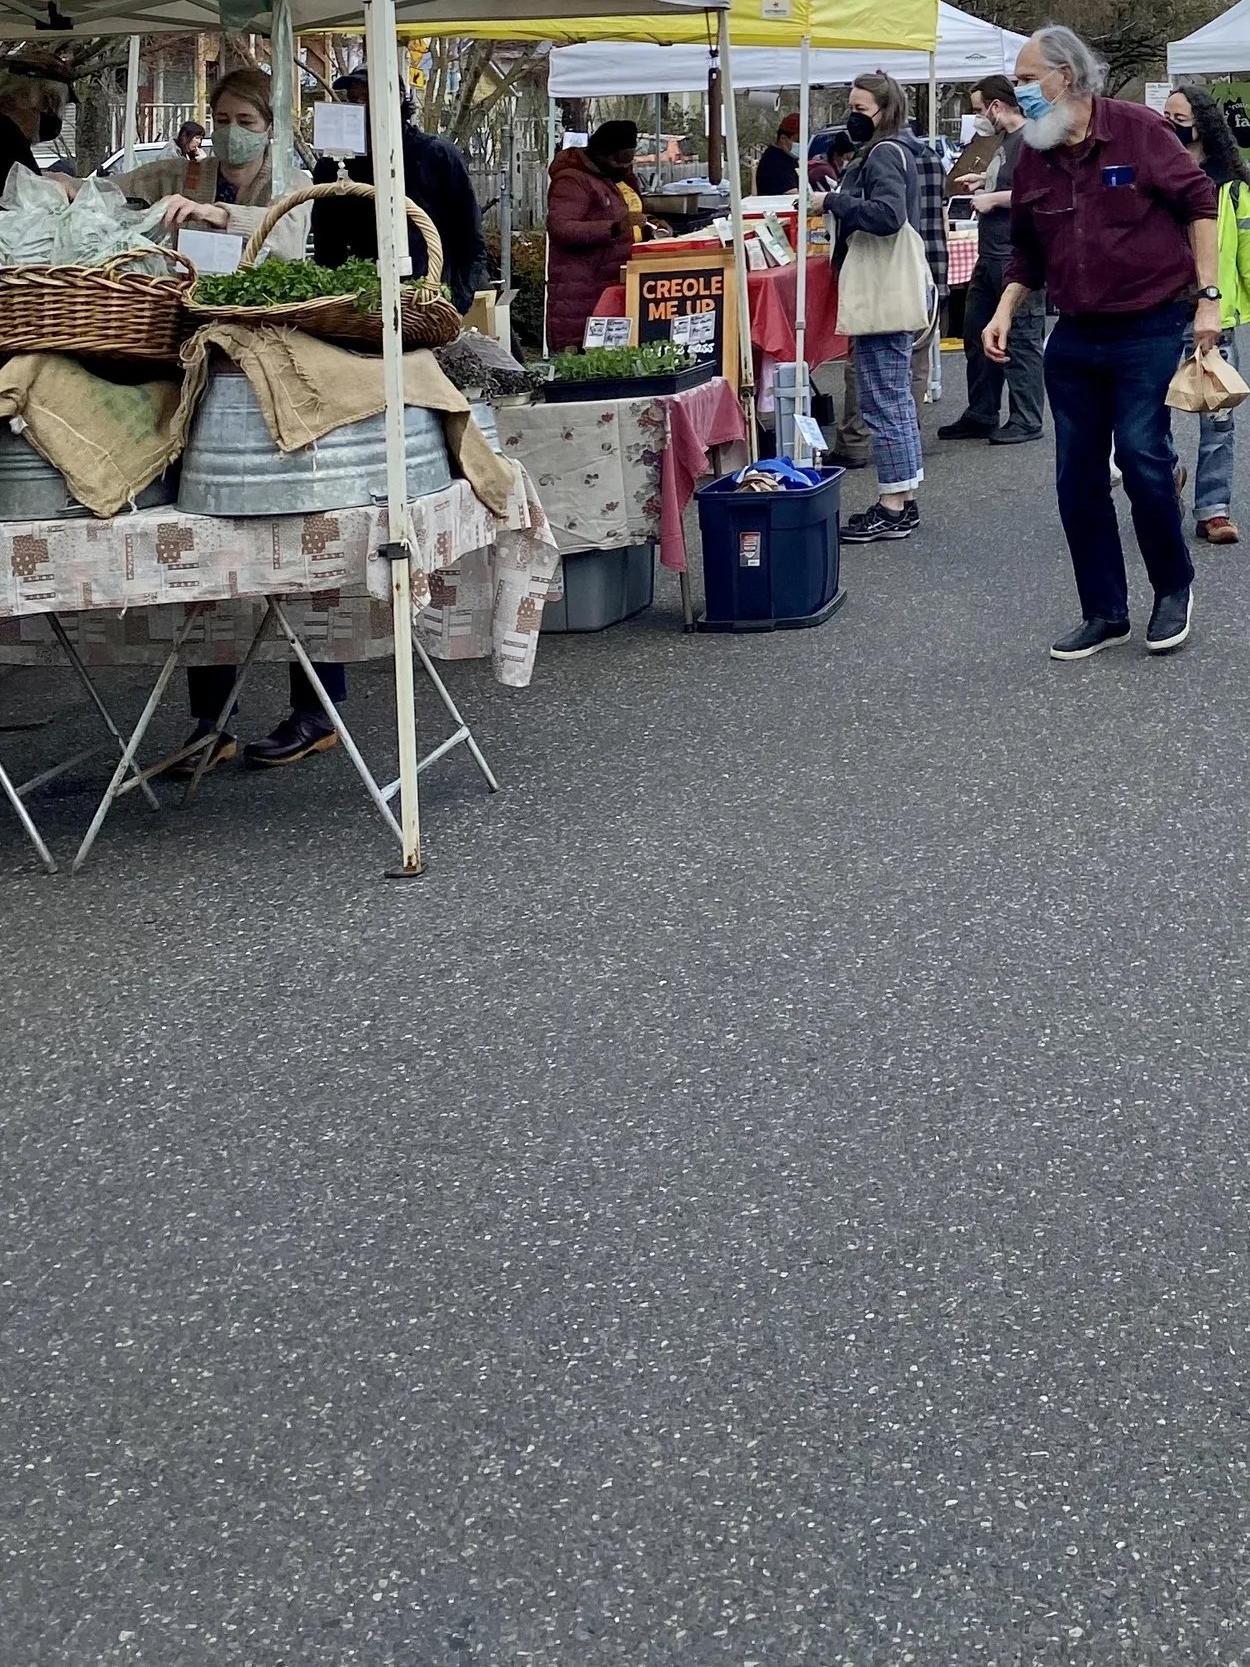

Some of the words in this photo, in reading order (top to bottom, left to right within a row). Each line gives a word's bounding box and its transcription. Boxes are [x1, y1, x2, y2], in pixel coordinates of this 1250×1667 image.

[642, 275, 723, 299] CREOLE
[648, 300, 680, 321] ME
[685, 298, 716, 316] UP
